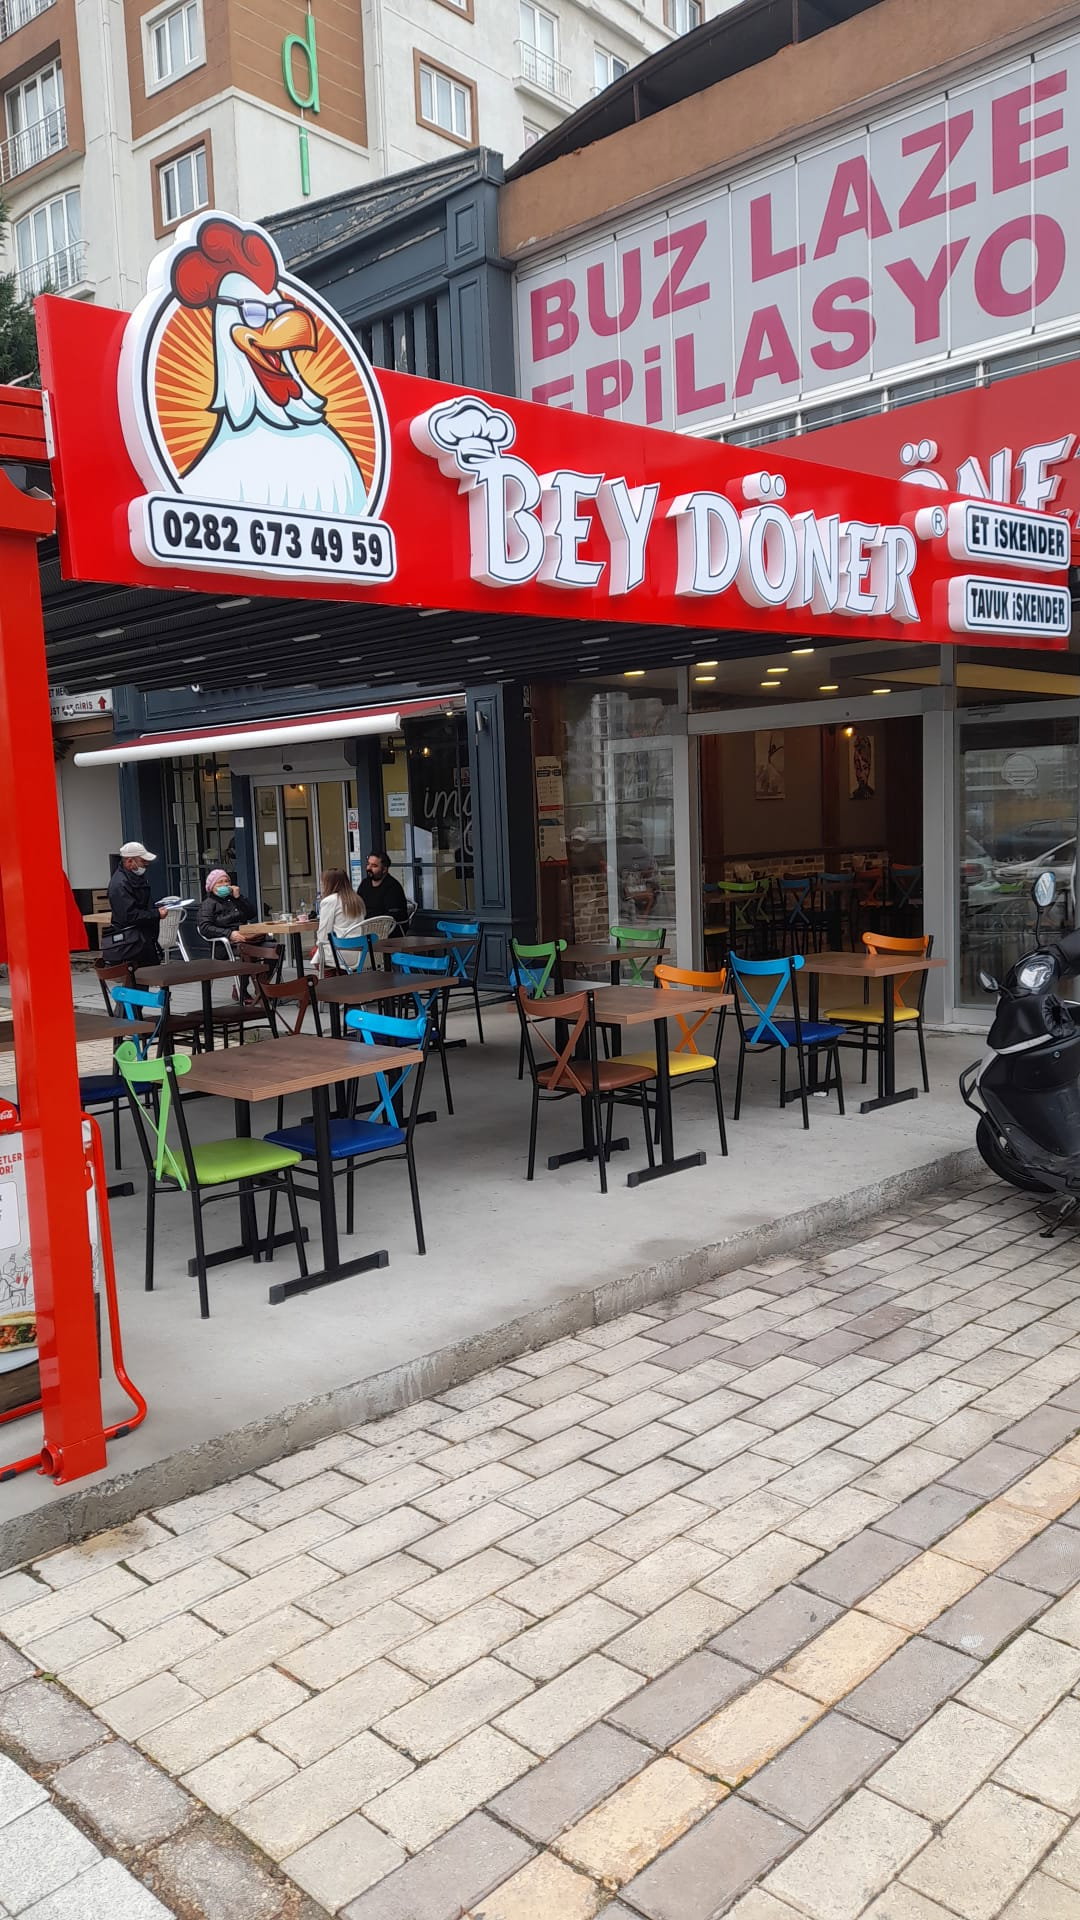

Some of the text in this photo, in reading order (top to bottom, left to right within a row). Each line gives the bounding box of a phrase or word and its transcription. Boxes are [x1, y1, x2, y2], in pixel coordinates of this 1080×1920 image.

[530, 219, 711, 363] BUZ
[163, 509, 383, 567] 0282 673 49 59
[468, 453, 661, 597] BEY
[674, 470, 922, 624] DÖNER
[971, 514, 989, 546] ET
[971, 587, 1009, 620] TAVUK
